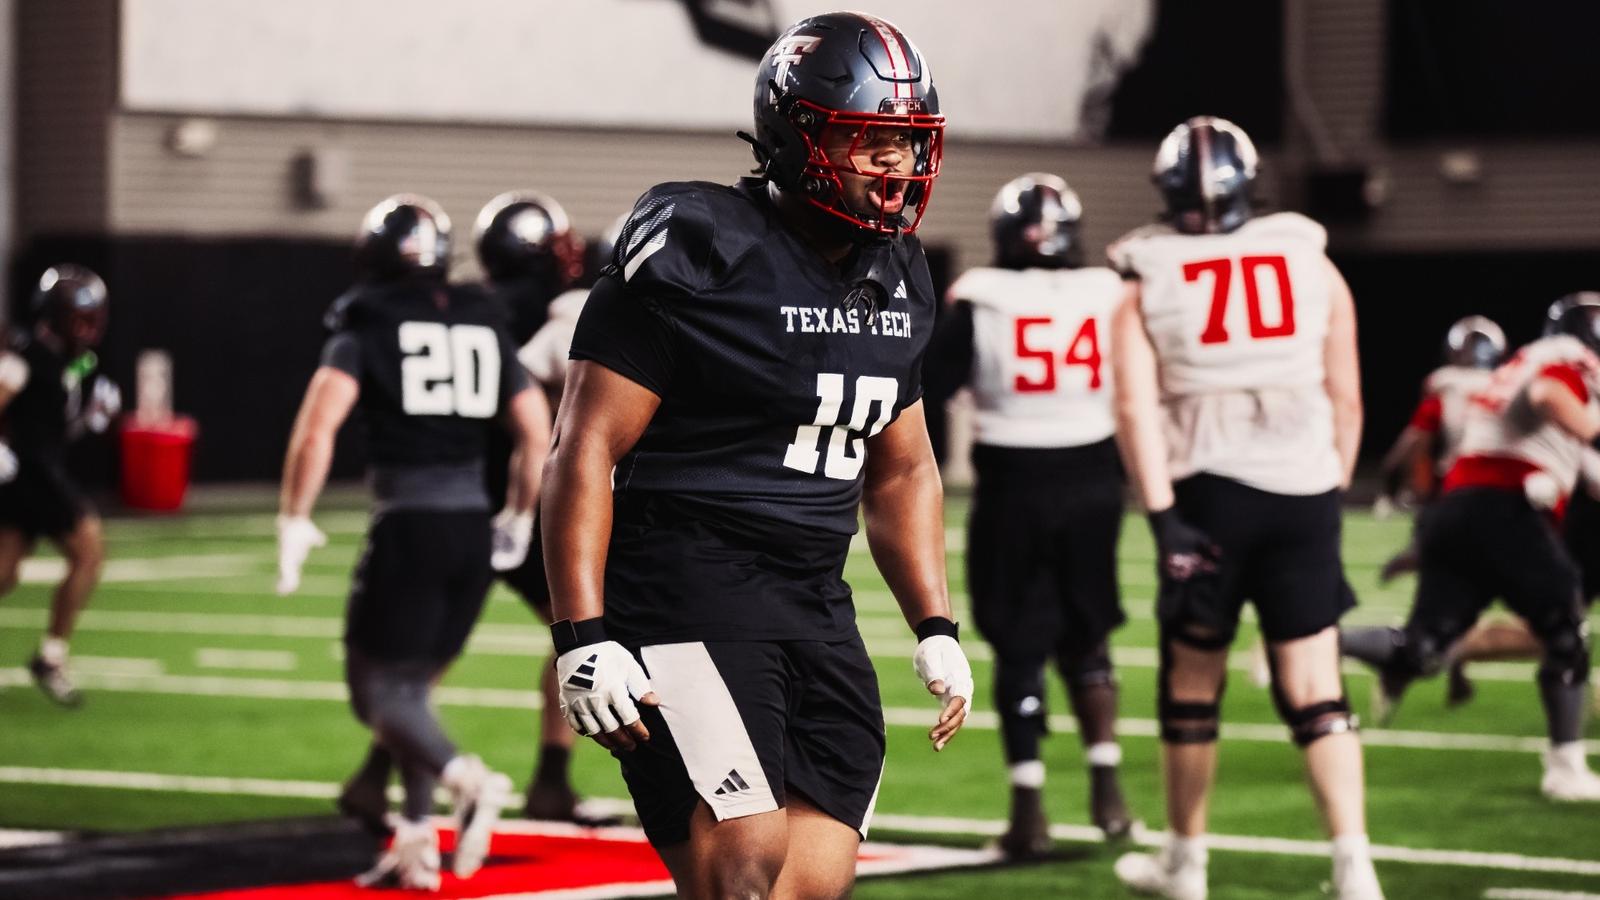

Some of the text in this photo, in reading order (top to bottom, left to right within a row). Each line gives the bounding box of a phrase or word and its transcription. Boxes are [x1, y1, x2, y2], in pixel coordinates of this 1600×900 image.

[780, 306, 860, 334] TEXAS
[1183, 255, 1295, 344] 70
[398, 321, 501, 418] 20
[1014, 317, 1102, 392] 54
[783, 373, 899, 480] 10
